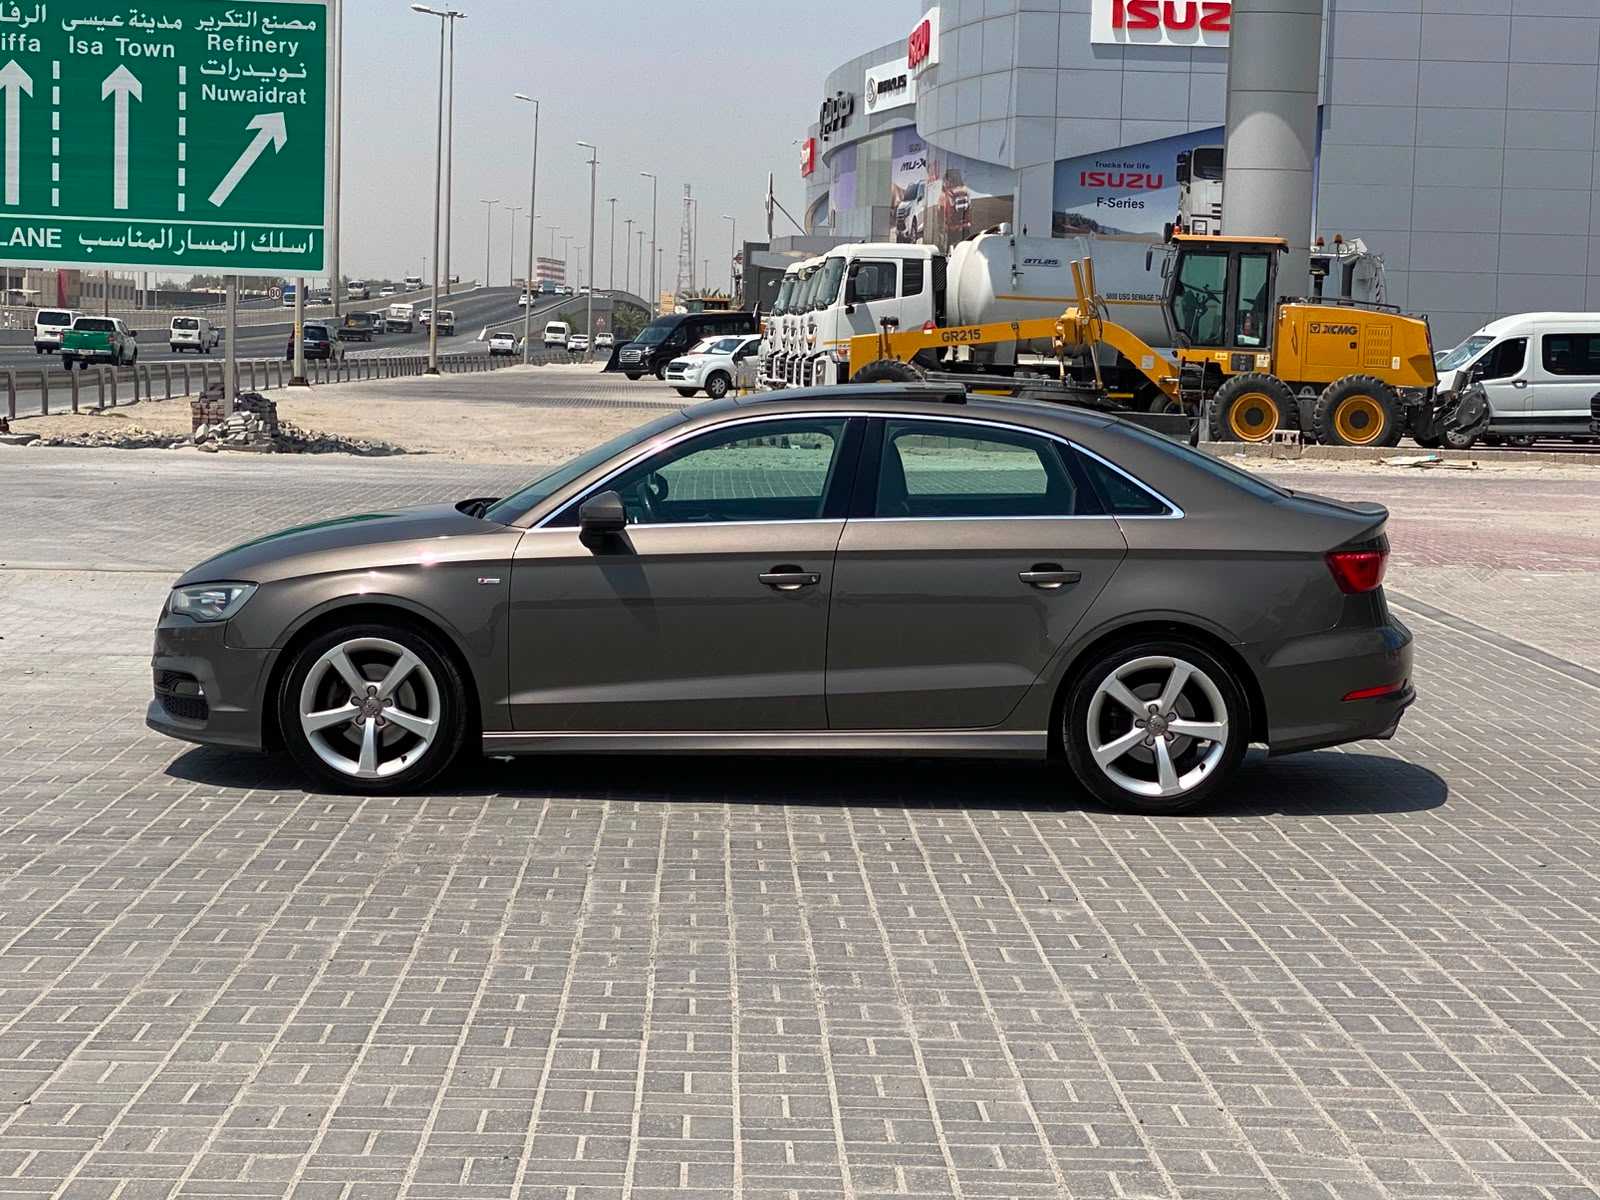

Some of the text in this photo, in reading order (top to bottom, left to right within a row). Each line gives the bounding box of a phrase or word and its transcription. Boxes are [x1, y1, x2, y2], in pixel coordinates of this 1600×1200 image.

[0, 1, 46, 28] الرفا
[62, 9, 182, 33] مدينة عيسى
[194, 10, 316, 34] مصنع التكرير
[1112, 0, 1231, 31] ISUZ
[0, 33, 41, 52] iffa
[69, 35, 175, 58] Isa Town
[207, 34, 299, 57] Refinery
[200, 57, 307, 82] نويدرات
[202, 84, 306, 104] Nuwaidrat
[1123, 161, 1134, 169] for
[1080, 172, 1163, 189] ISUZU
[1096, 197, 1145, 209] F-Series
[251, 232, 314, 253] اسلك
[271, 288, 280, 298] 80
[942, 329, 981, 342] GR215
[1322, 325, 1358, 335] XCMG
